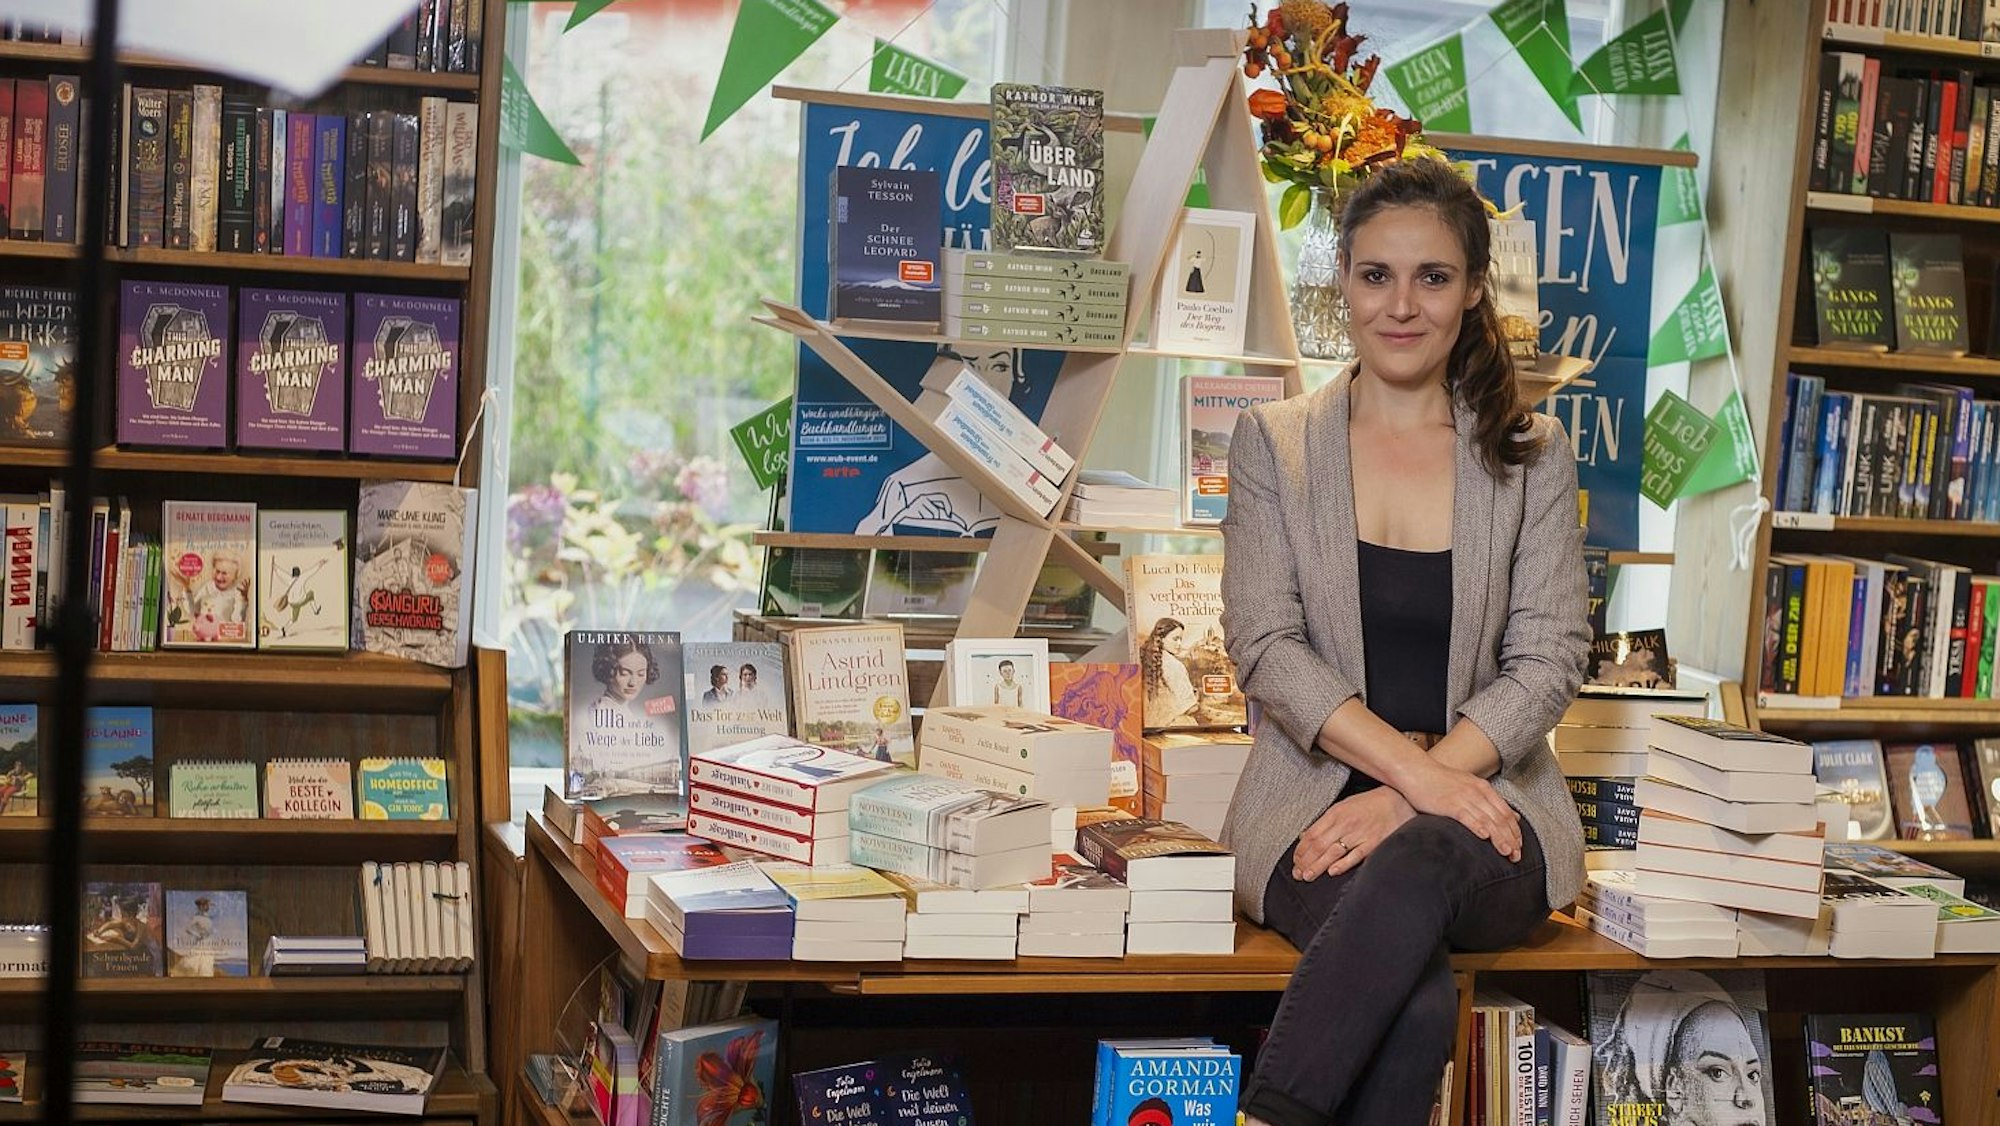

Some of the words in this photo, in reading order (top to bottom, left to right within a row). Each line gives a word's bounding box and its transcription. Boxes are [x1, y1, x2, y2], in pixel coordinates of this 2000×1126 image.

[1642, 30, 1674, 82] LESEN
[884, 52, 945, 97] LESEN
[1401, 46, 1452, 89] LESEN
[1006, 90, 1055, 103] RAYNOR
[1063, 94, 1096, 107] WINN
[1834, 114, 1847, 140] TOD
[1846, 111, 1859, 145] LAND
[1030, 140, 1076, 166] ÜBER
[1910, 122, 1924, 173] FITZEK
[1048, 166, 1095, 188] LAND
[871, 179, 910, 192] Sylvain
[868, 191, 914, 202] TESSON
[881, 224, 900, 234] Der
[867, 234, 914, 246] SCHNEE
[863, 246, 918, 258] LEOPARD
[159, 287, 222, 299] McDONNELL
[278, 295, 340, 306] McDONNELL
[1828, 290, 1877, 302] GANGS
[1177, 302, 1202, 313] Paulo
[1203, 303, 1233, 314] Coelho
[1907, 296, 1954, 308] GANGS
[16, 302, 72, 320] WELT
[167, 331, 187, 341] THIS
[131, 338, 221, 367] CHARMING
[250, 344, 339, 372] CHARMING
[364, 351, 452, 378] CHARMING
[157, 364, 194, 383] MAN
[276, 372, 313, 387] MAN
[390, 377, 426, 395] MAN
[1655, 398, 1710, 452] Lieb
[806, 455, 879, 463] www.wub-event.de
[823, 467, 862, 478] arte
[176, 512, 205, 522] RENATE
[207, 513, 251, 523] BERGMANN
[377, 509, 420, 523] MARC-UWE
[422, 512, 446, 524] KLING
[1142, 564, 1170, 575] Luca
[1175, 564, 1189, 574] Di
[1175, 578, 1196, 589] Das
[1170, 603, 1224, 616] Paradies
[578, 634, 630, 645] ULRIKE
[639, 635, 675, 645] RENK
[823, 648, 885, 670] Astrid
[808, 669, 902, 694] Lindgren
[594, 708, 624, 728] Ulla
[691, 709, 712, 722] Das
[714, 709, 732, 722] Tor
[757, 709, 783, 722] Welt
[716, 724, 766, 737] Hoffnung
[586, 733, 617, 748] Wege
[635, 733, 664, 746] Liebe
[1846, 752, 1875, 766] CLARK
[290, 786, 323, 798] BESTE
[370, 778, 439, 791] HOMEOFFICE
[284, 799, 341, 813] KOLLEGIN
[93, 952, 150, 964] Schreibende
[105, 963, 138, 972] Frauen
[1840, 1027, 1905, 1043] BANKSY
[912, 1058, 932, 1069] Julia
[1518, 1041, 1533, 1074] 100
[901, 1067, 944, 1084] Engelmann
[1130, 1059, 1235, 1077] AMANDA
[835, 1075, 856, 1087] Julia
[1128, 1079, 1234, 1096] GORMAN
[1571, 1069, 1584, 1104] SEHEN
[825, 1086, 866, 1104] Engelmann
[902, 1089, 921, 1102] Die
[923, 1084, 950, 1100] Welt
[825, 1109, 845, 1123] Die
[846, 1102, 872, 1120] Welt
[898, 1104, 920, 1118] mit
[922, 1103, 959, 1115] deinen
[1184, 1099, 1212, 1117] Was
[1607, 1103, 1665, 1117] STREET
